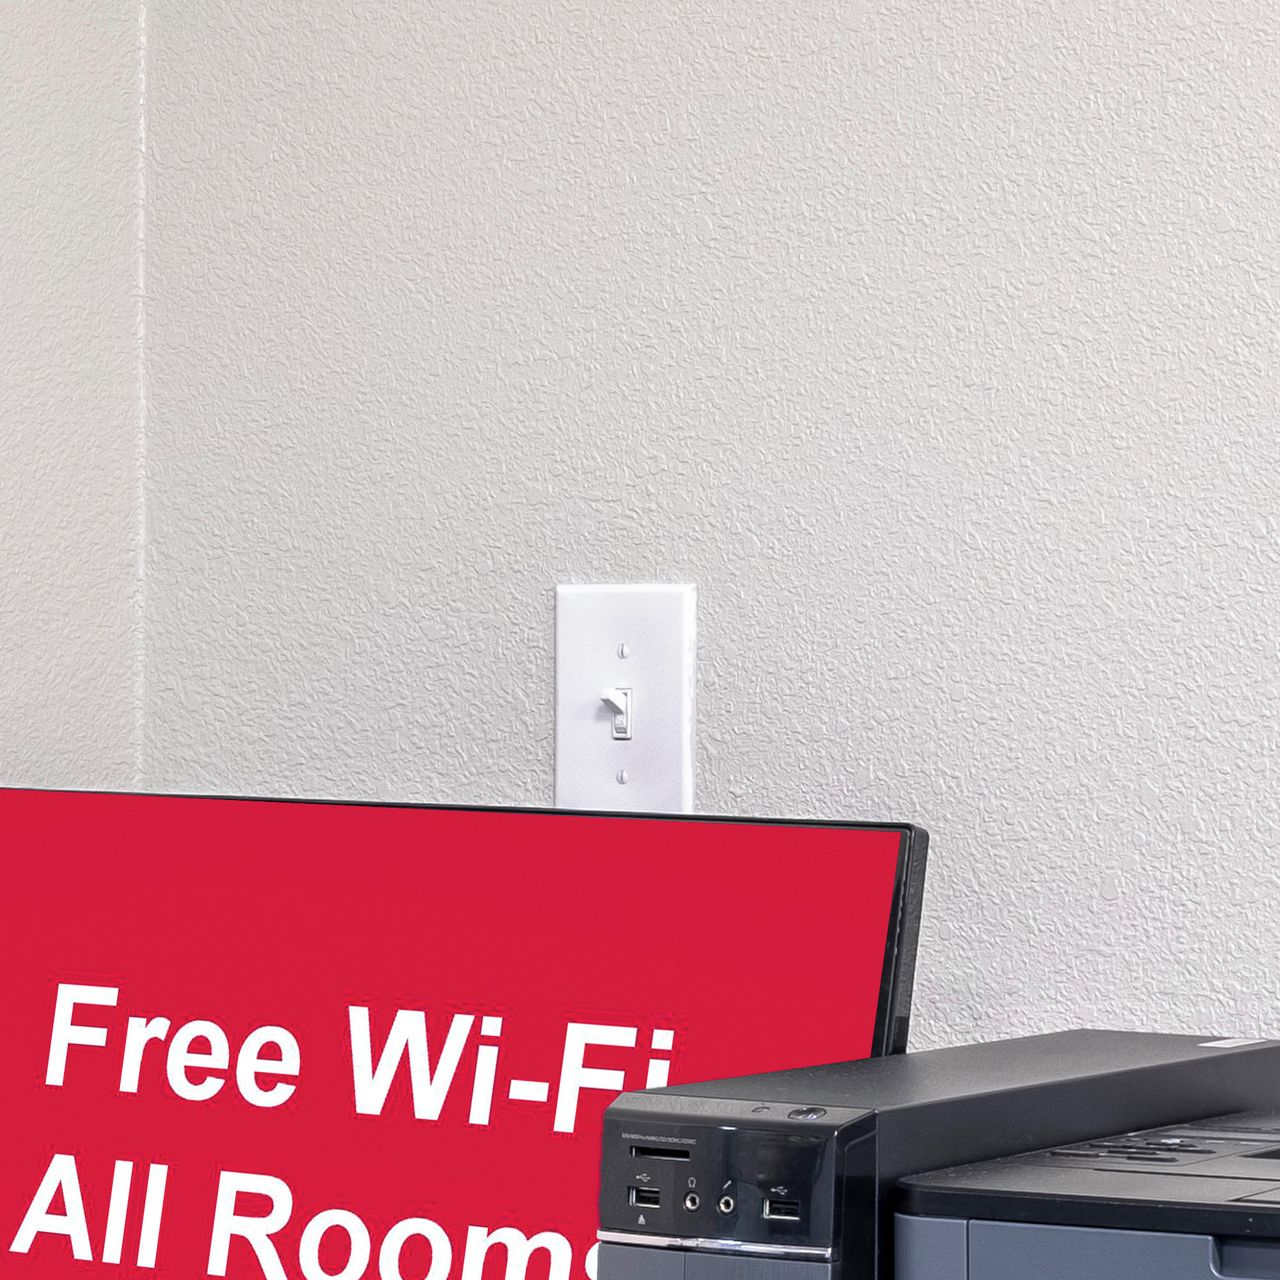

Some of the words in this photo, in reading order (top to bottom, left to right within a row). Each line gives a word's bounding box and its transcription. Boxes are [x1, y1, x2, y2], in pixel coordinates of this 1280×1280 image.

[46, 984, 300, 1107] Free
[349, 1006, 674, 1133] Wi-Fi
[10, 1154, 168, 1268] All
